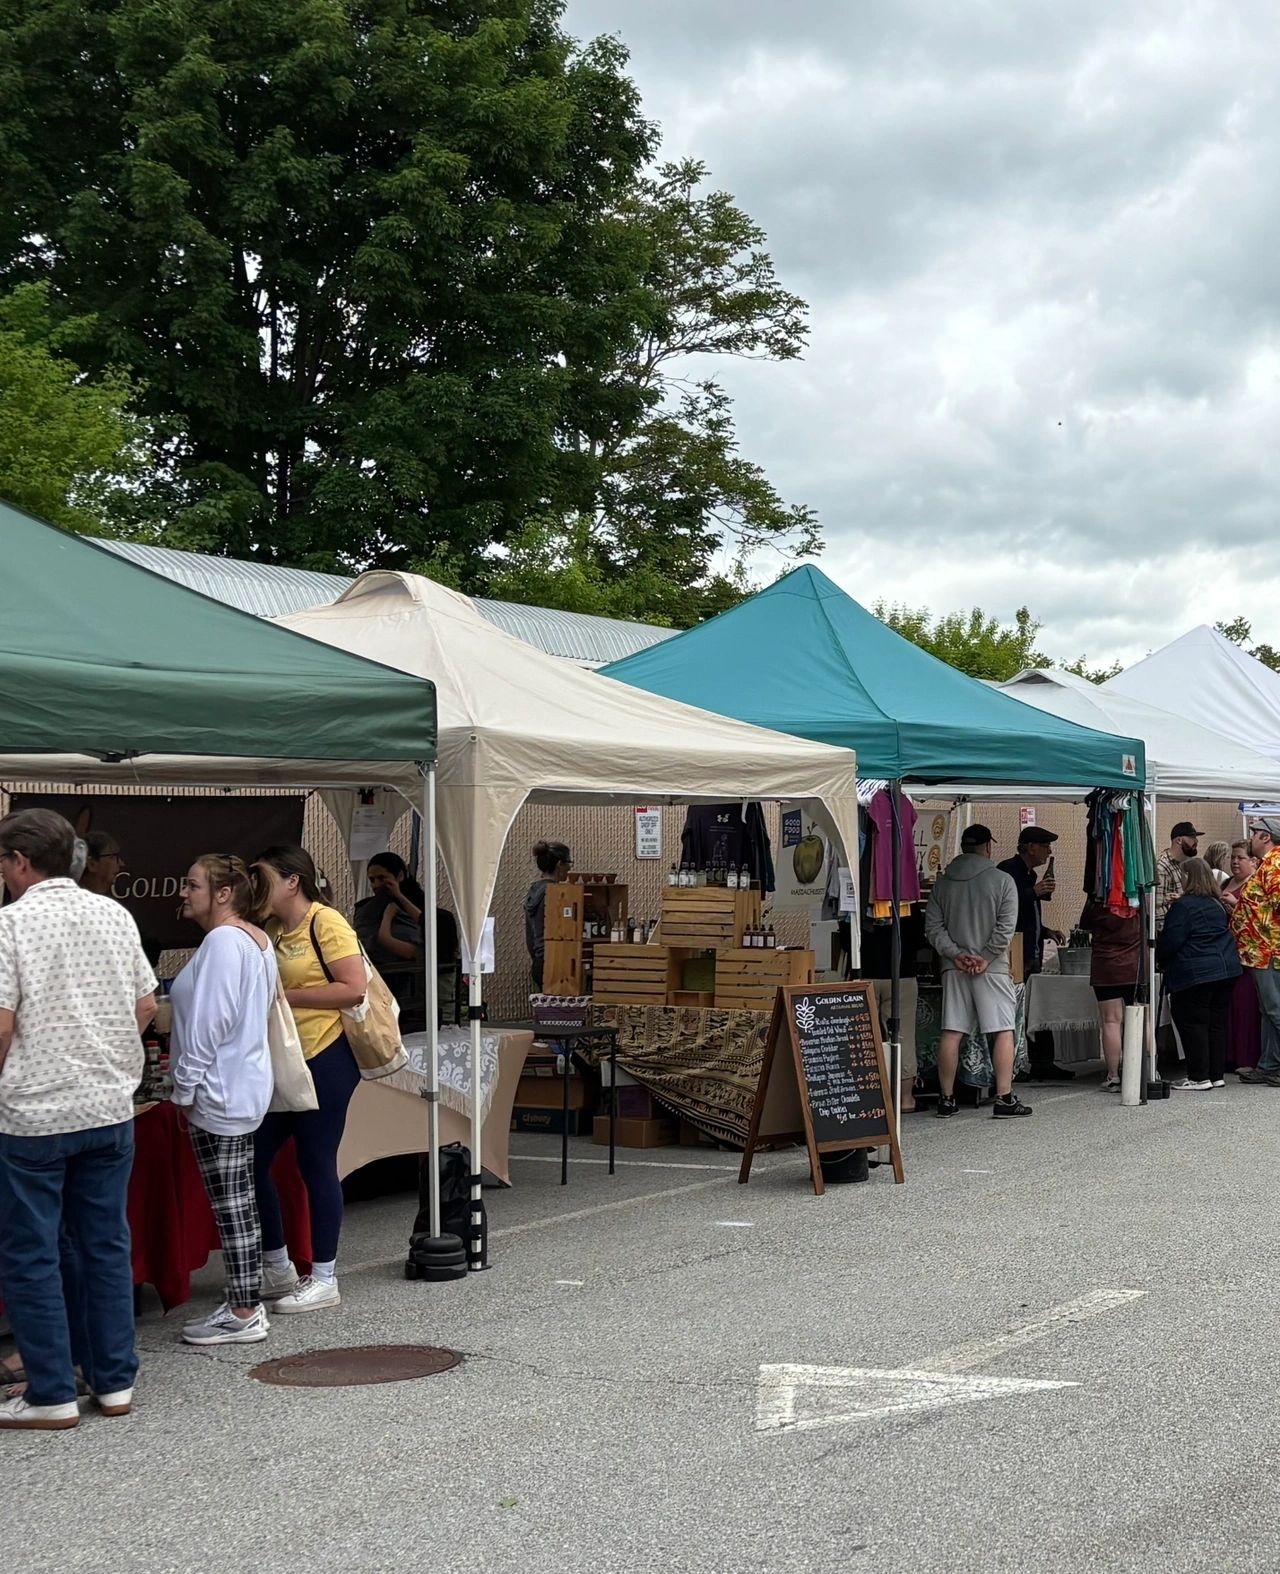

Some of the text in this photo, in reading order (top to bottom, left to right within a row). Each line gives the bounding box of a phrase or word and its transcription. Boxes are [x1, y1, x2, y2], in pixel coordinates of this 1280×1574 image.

[784, 818, 801, 827] GOOD
[784, 826, 801, 834] FOOD
[815, 994, 864, 1005] GOLDEN GRAIN
